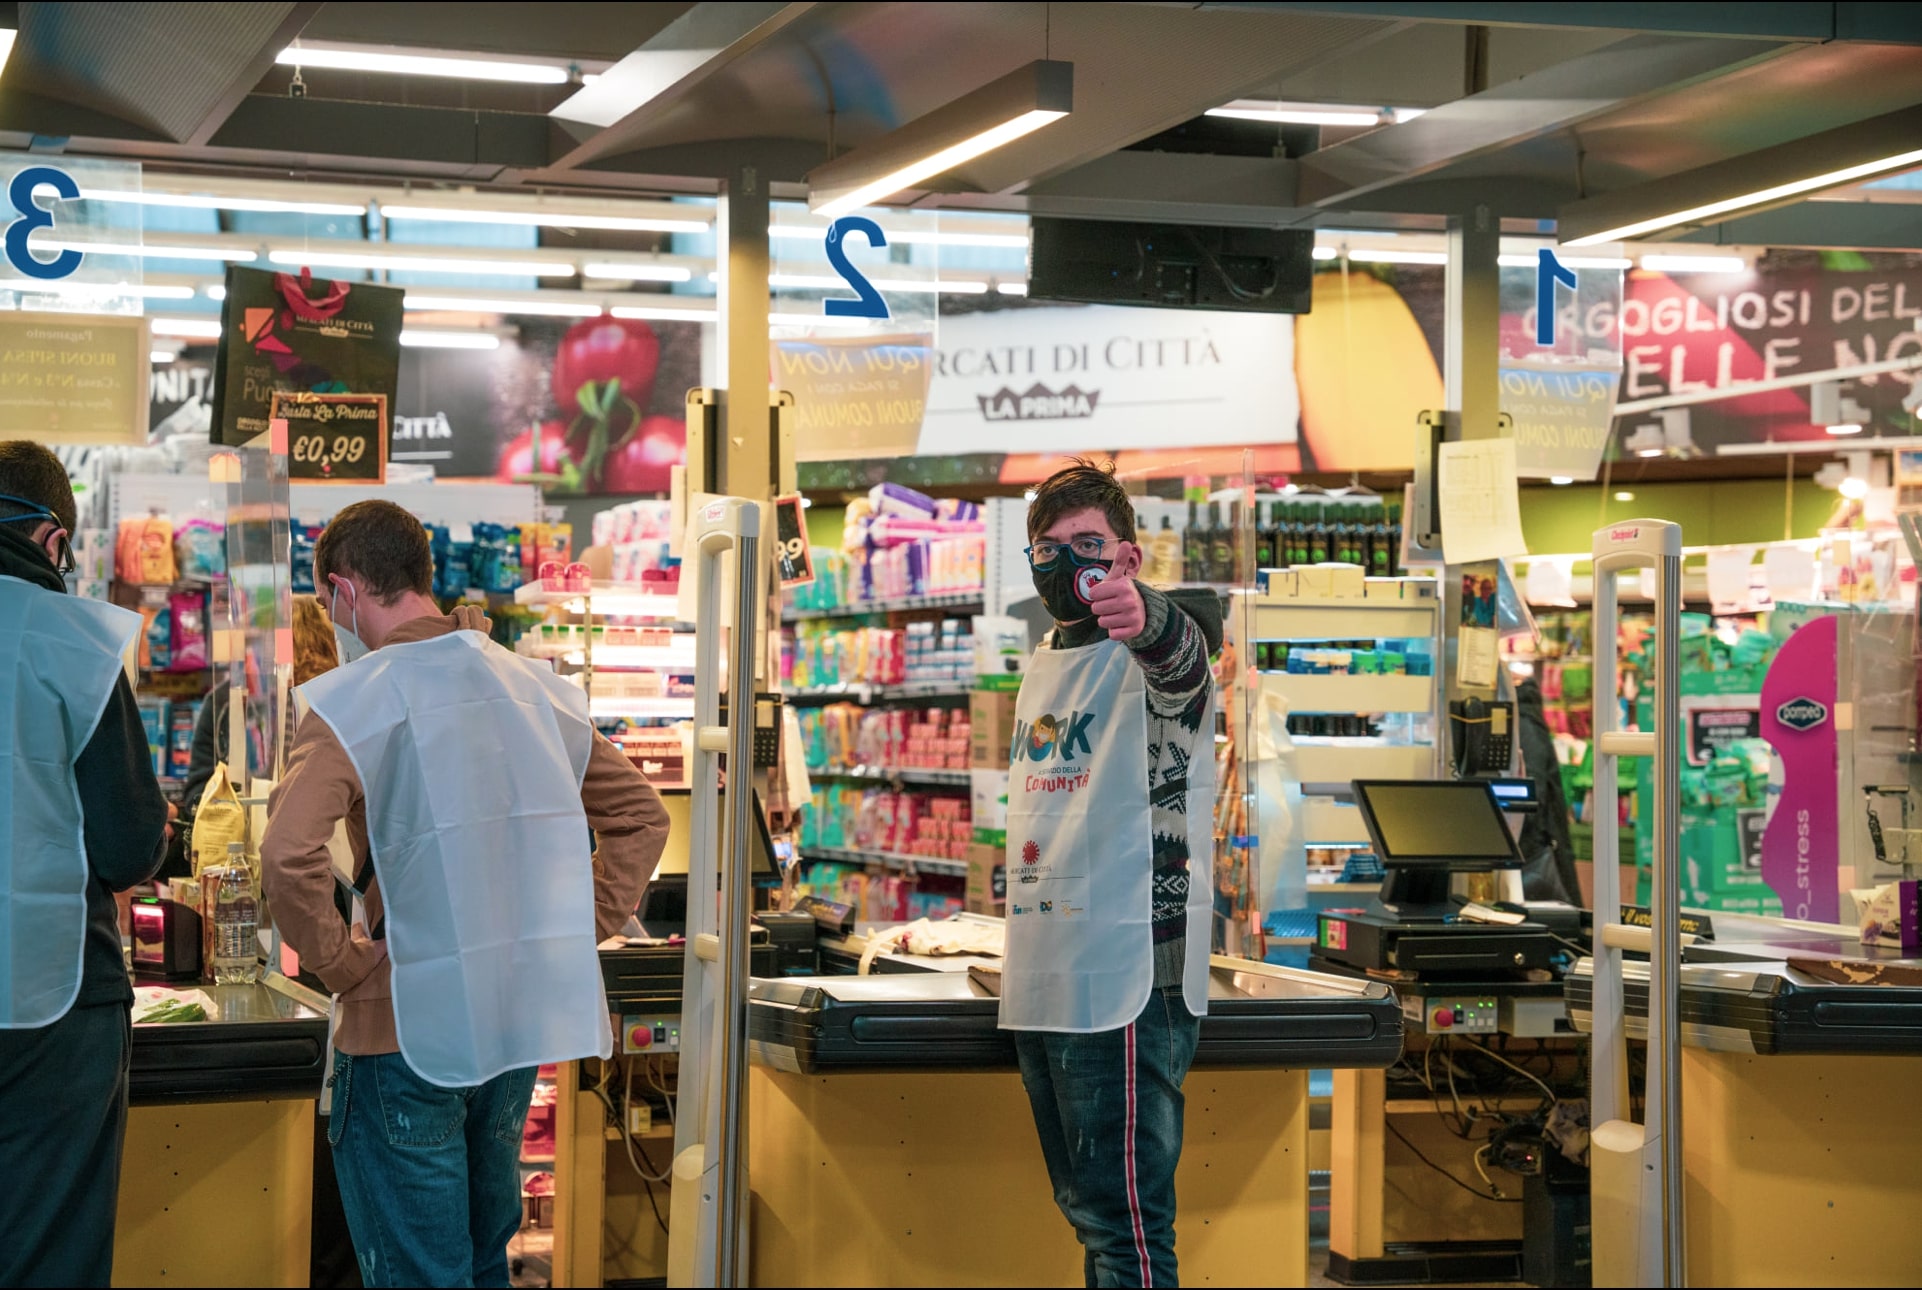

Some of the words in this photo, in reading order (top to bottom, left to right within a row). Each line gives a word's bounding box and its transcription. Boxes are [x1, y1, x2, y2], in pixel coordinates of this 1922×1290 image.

[1053, 343, 1091, 373] DI
[335, 403, 378, 420] Prima
[984, 397, 1017, 419] LA
[1020, 394, 1091, 419] PRIMA
[292, 435, 366, 467] €0,99
[1025, 767, 1091, 793] COMUNITÀ
